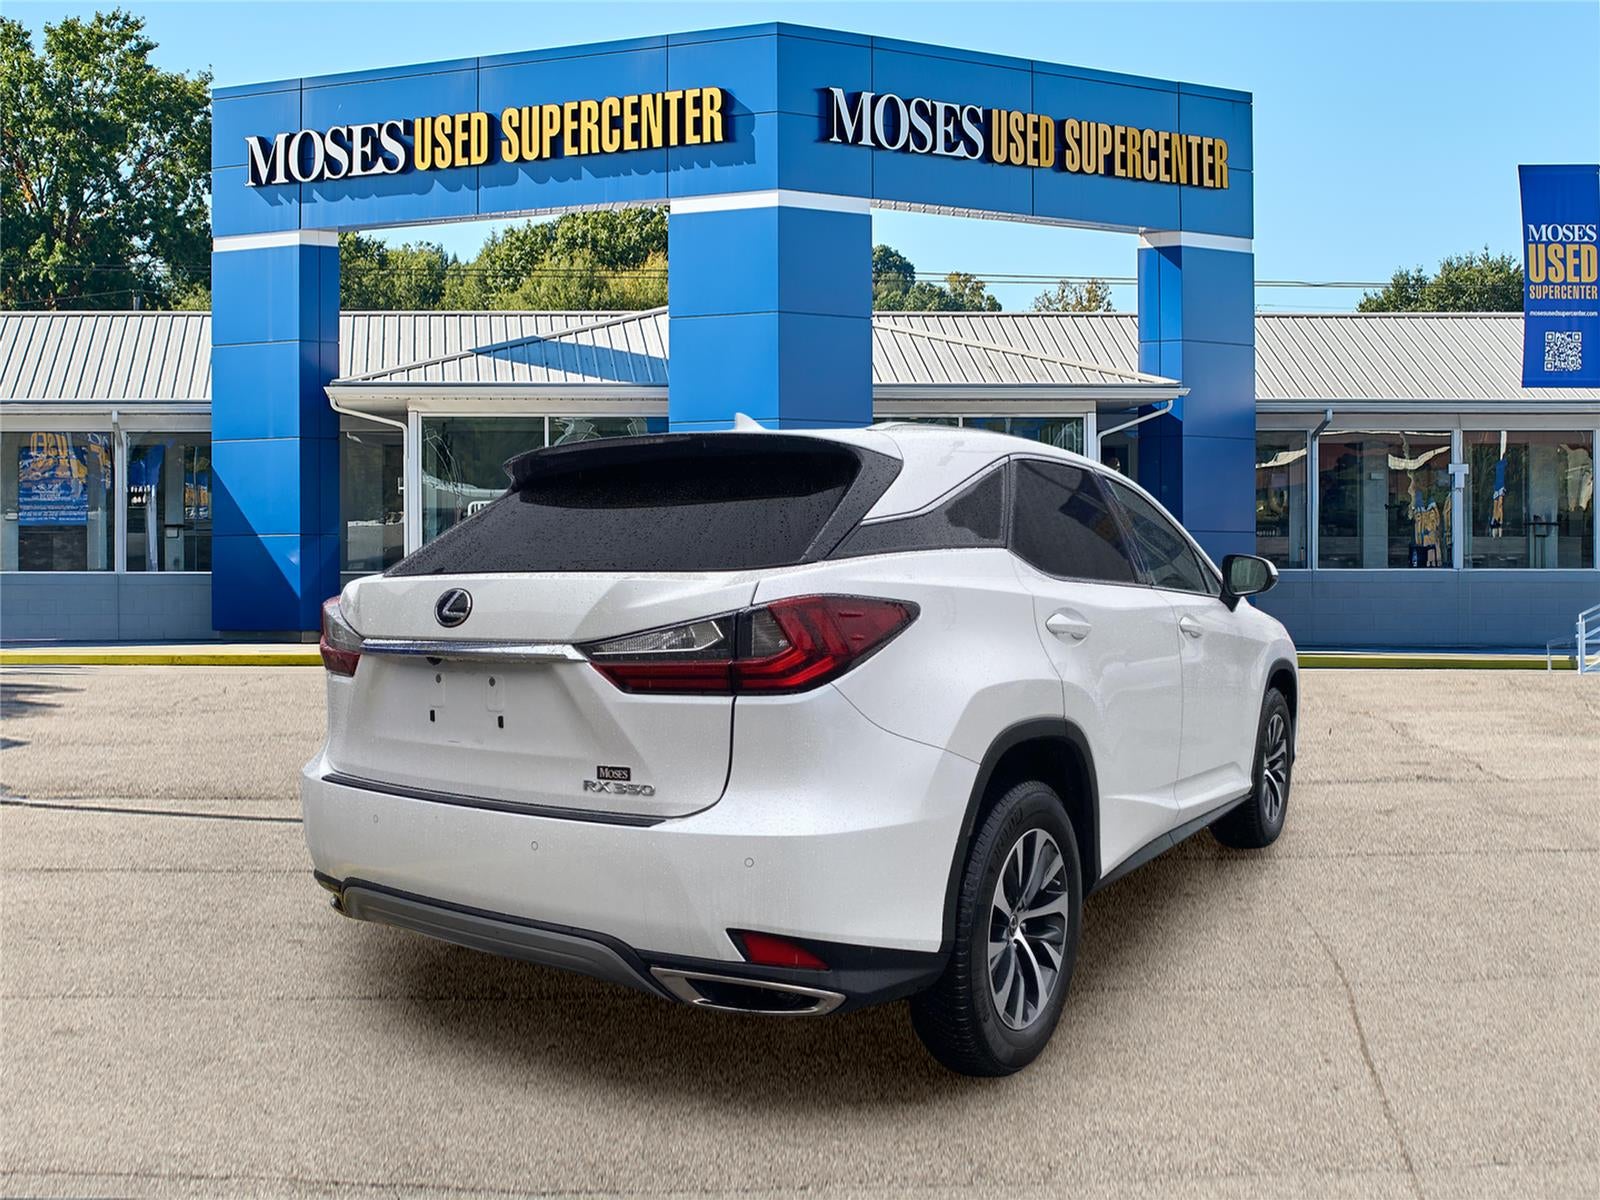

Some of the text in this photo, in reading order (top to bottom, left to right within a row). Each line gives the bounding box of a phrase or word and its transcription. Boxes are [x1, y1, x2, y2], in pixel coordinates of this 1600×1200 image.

[244, 86, 724, 187] MOSES USED SUPERCENTER
[828, 86, 1230, 189] MOSES USED SUPERCENTER
[1527, 223, 1597, 243] MOSES
[1528, 243, 1598, 283] USED
[1529, 285, 1598, 300] SUPERCENTER
[583, 780, 656, 797] RX 350
